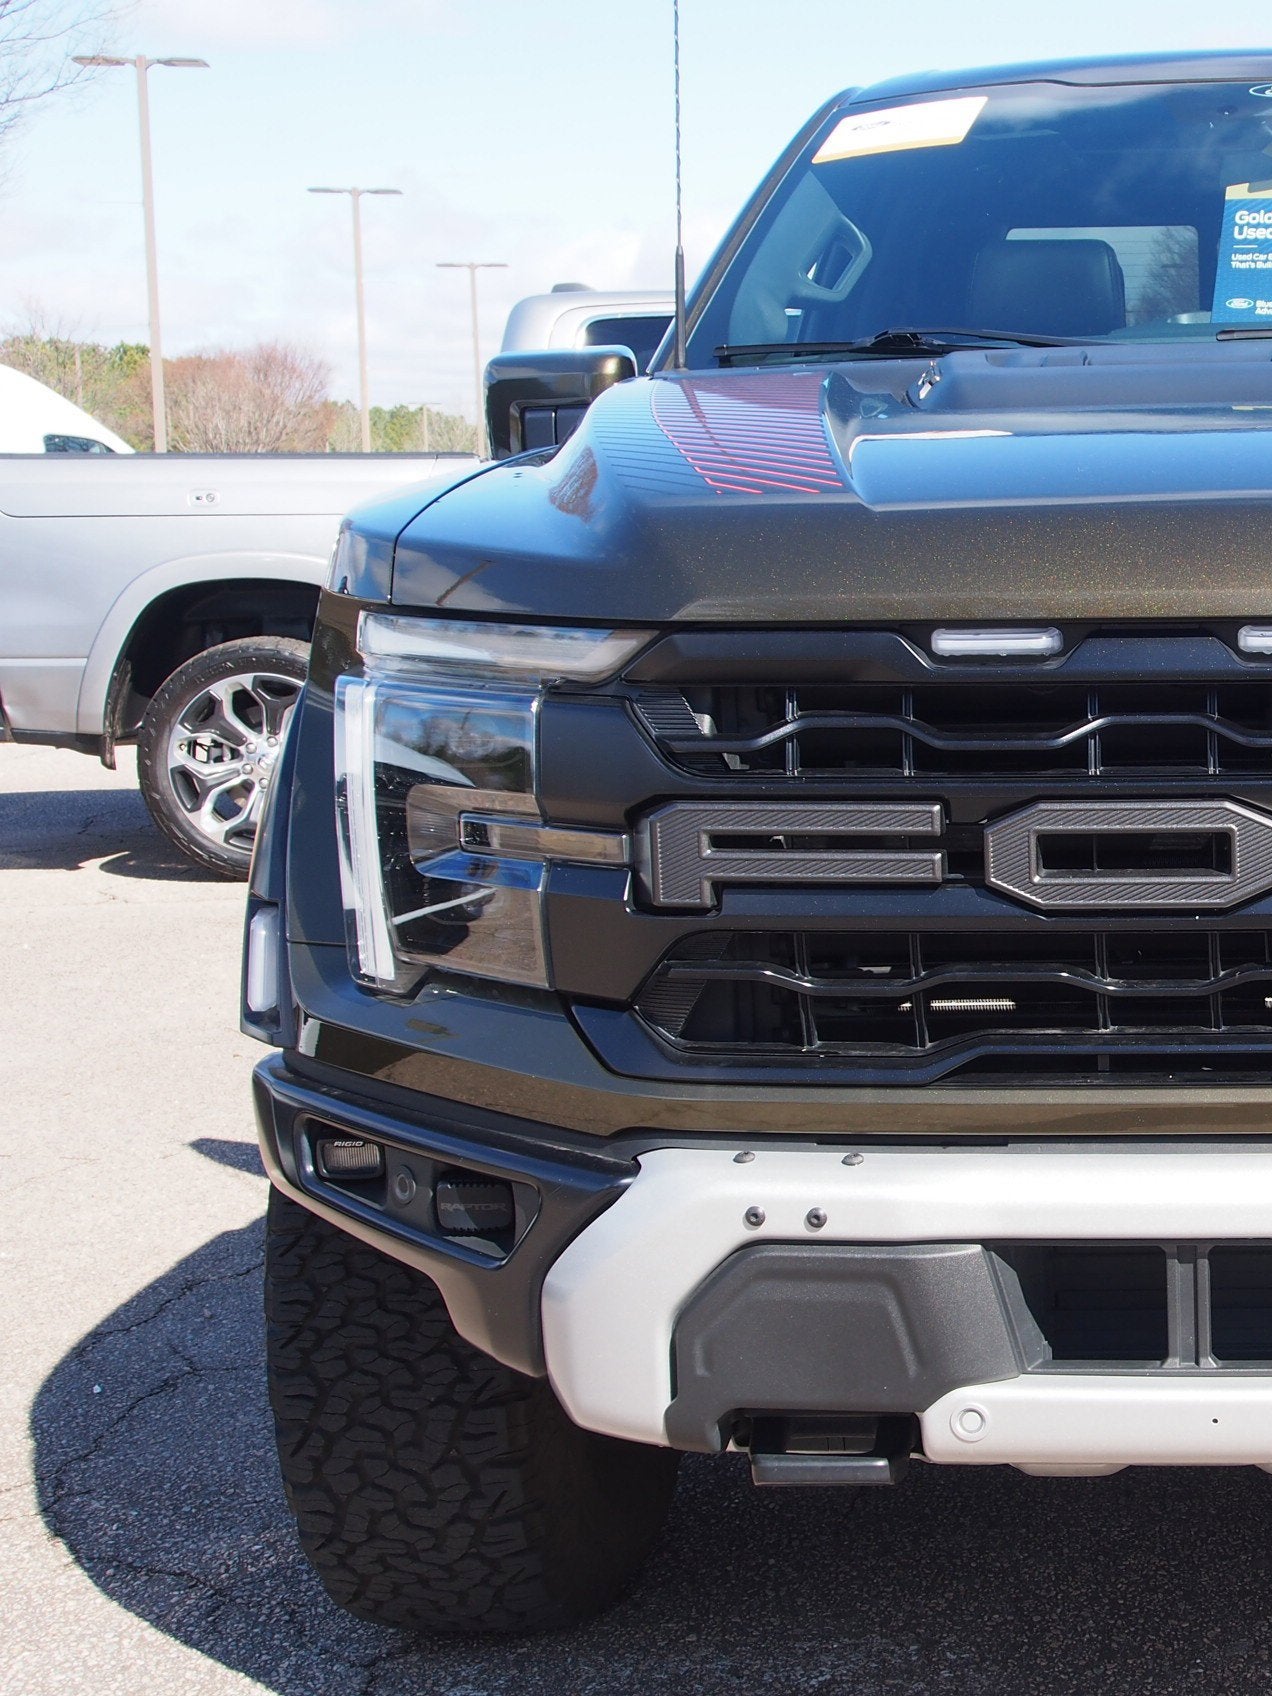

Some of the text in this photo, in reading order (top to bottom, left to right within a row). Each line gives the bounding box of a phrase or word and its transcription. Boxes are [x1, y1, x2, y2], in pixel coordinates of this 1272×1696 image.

[1231, 253, 1252, 261] Used
[1252, 253, 1267, 261] Car
[1230, 261, 1255, 269] That's
[439, 1202, 509, 1213] RAPTOR
